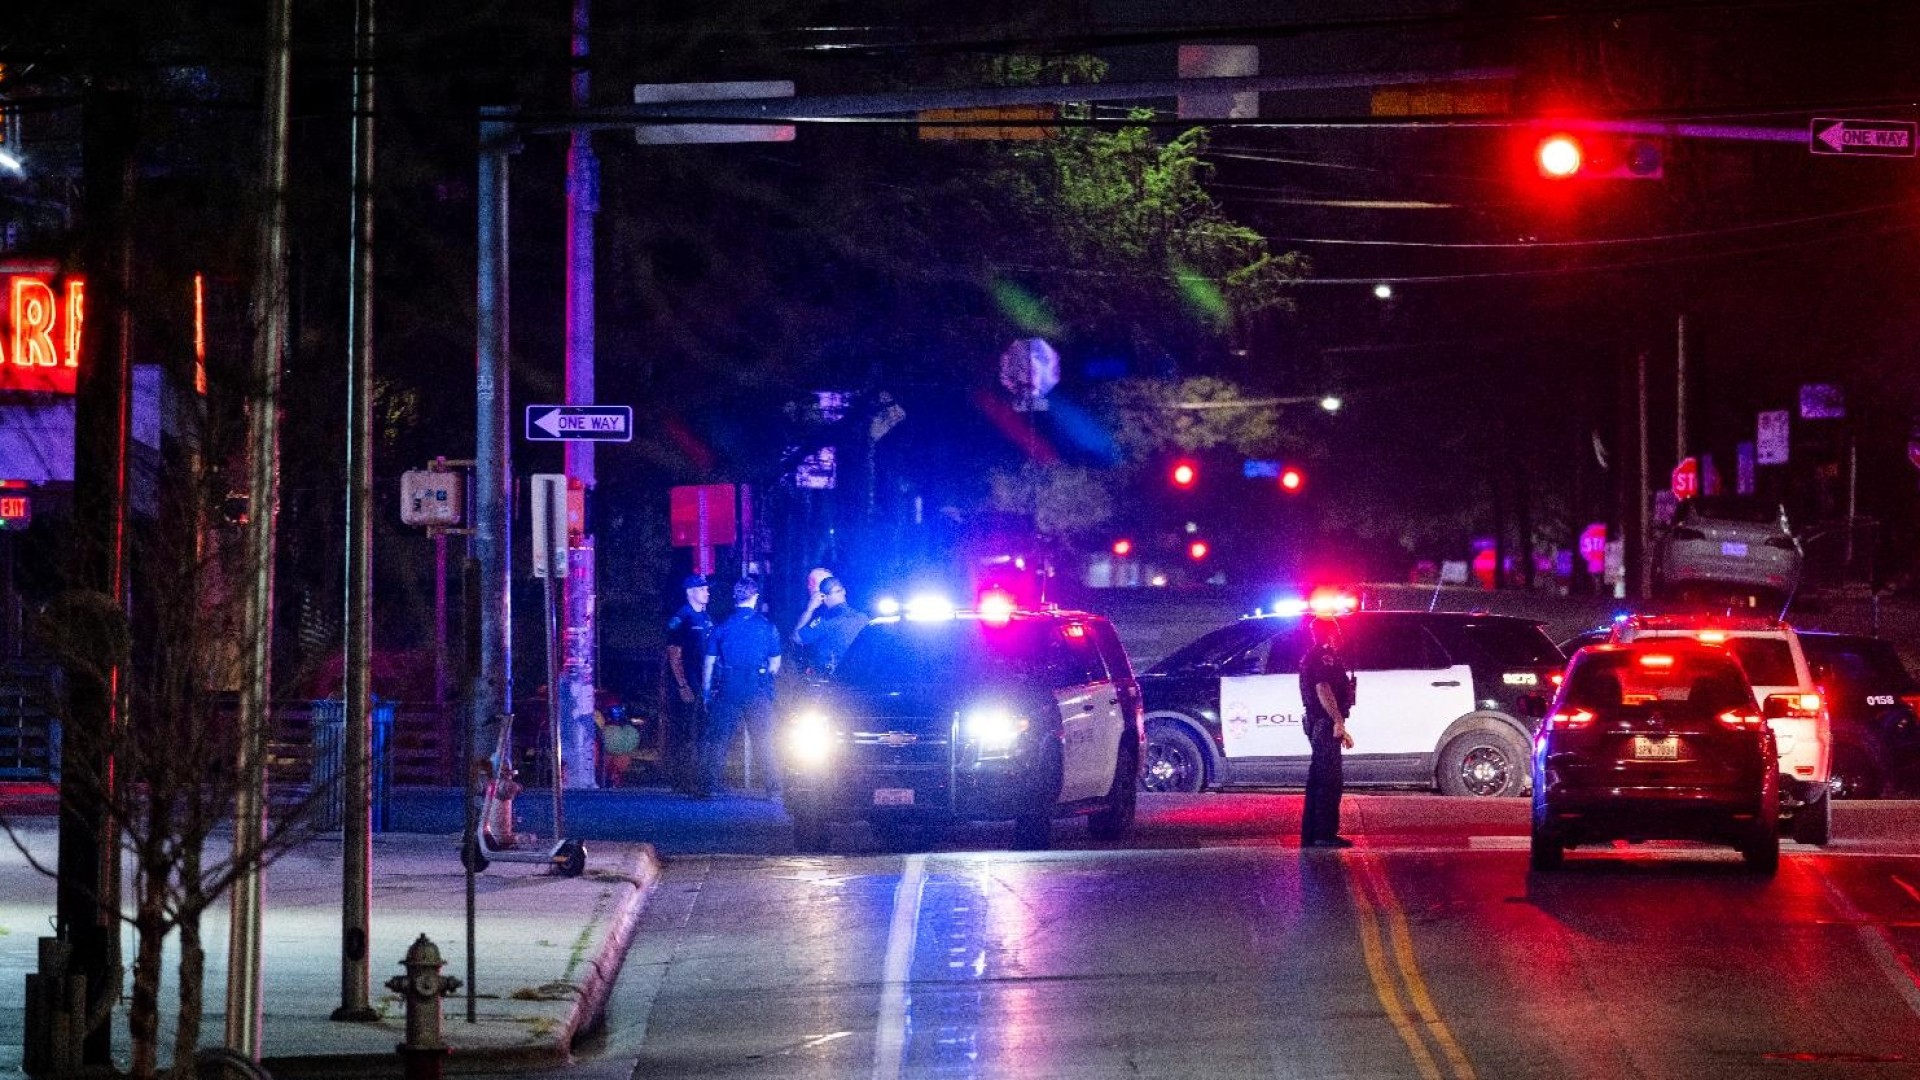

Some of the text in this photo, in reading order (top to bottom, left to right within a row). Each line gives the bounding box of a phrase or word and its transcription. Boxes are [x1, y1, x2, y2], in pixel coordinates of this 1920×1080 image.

[1842, 130, 1906, 147] ONE WAY
[559, 417, 619, 430] ONE WAY
[1676, 473, 1695, 491] ST
[1, 498, 26, 517] EXIT
[1866, 695, 1895, 706] 0158
[1256, 714, 1299, 724] POL
